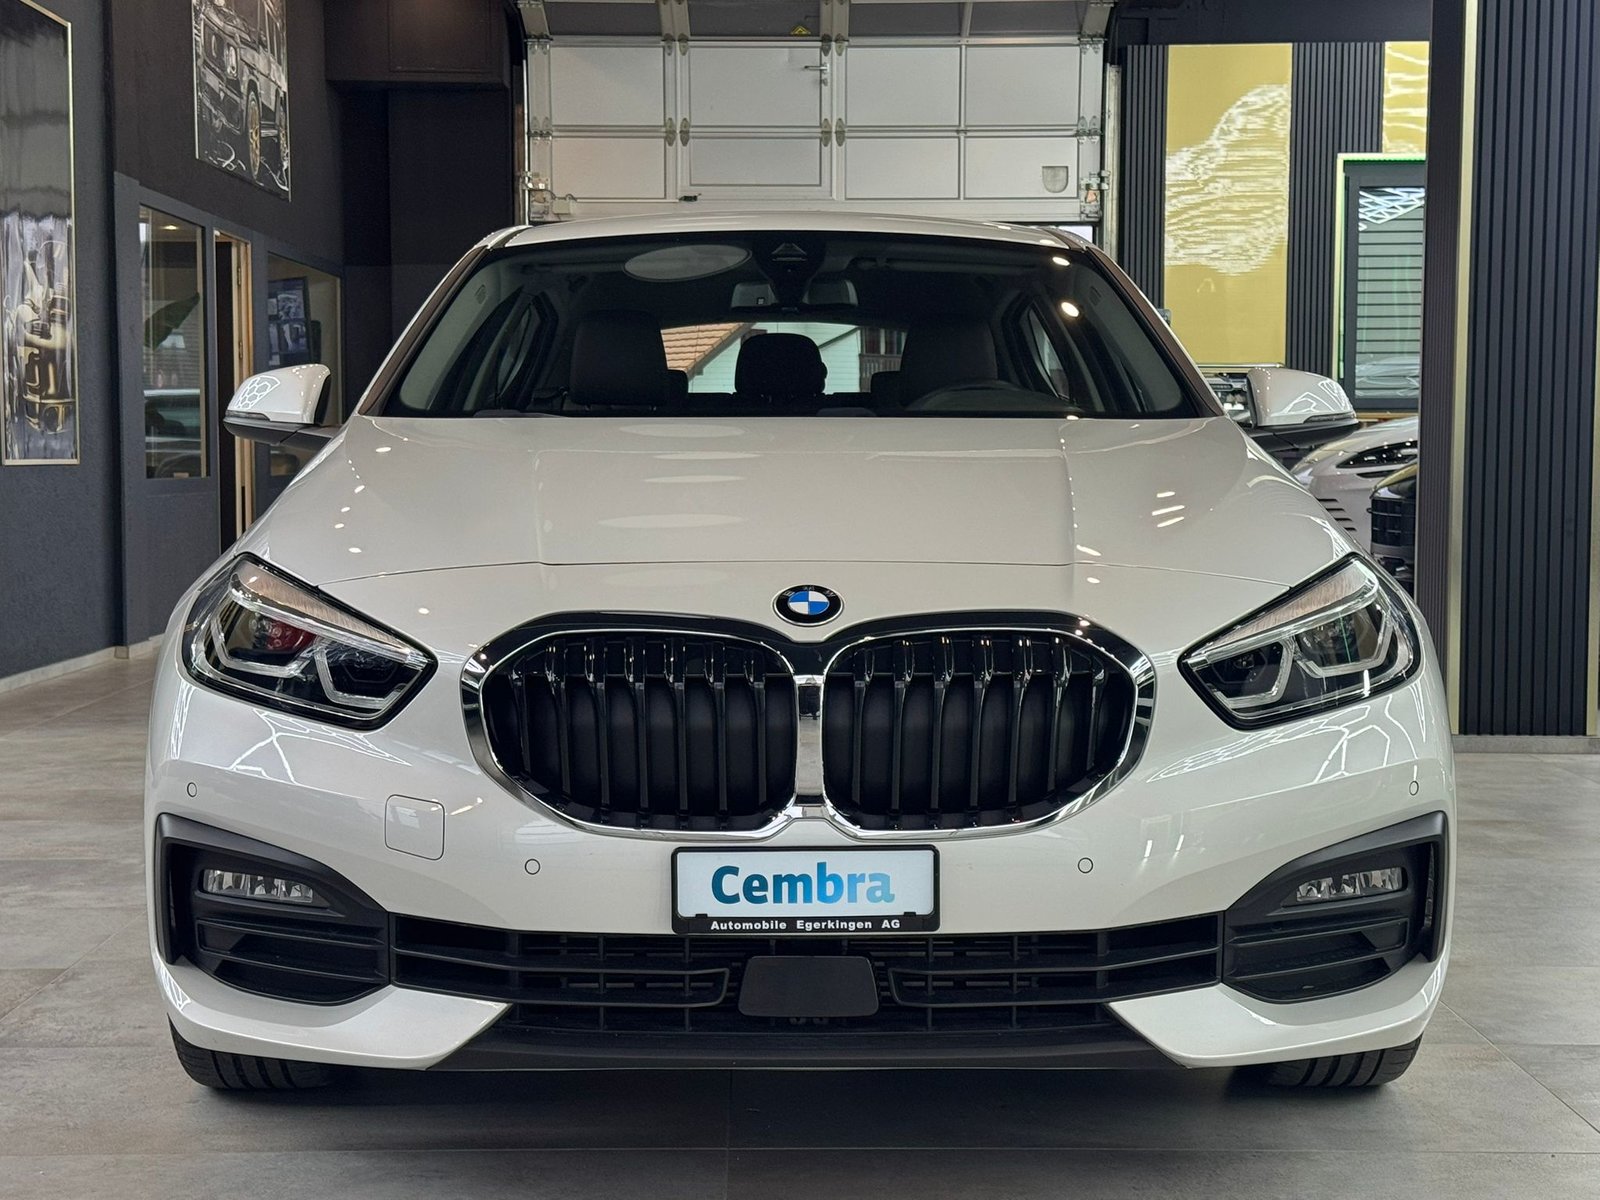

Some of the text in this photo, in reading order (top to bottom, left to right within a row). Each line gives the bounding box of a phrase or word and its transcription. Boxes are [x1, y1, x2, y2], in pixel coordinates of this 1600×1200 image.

[711, 861, 896, 904] Cembra
[711, 919, 900, 931] Automobile Egerkingen AG
